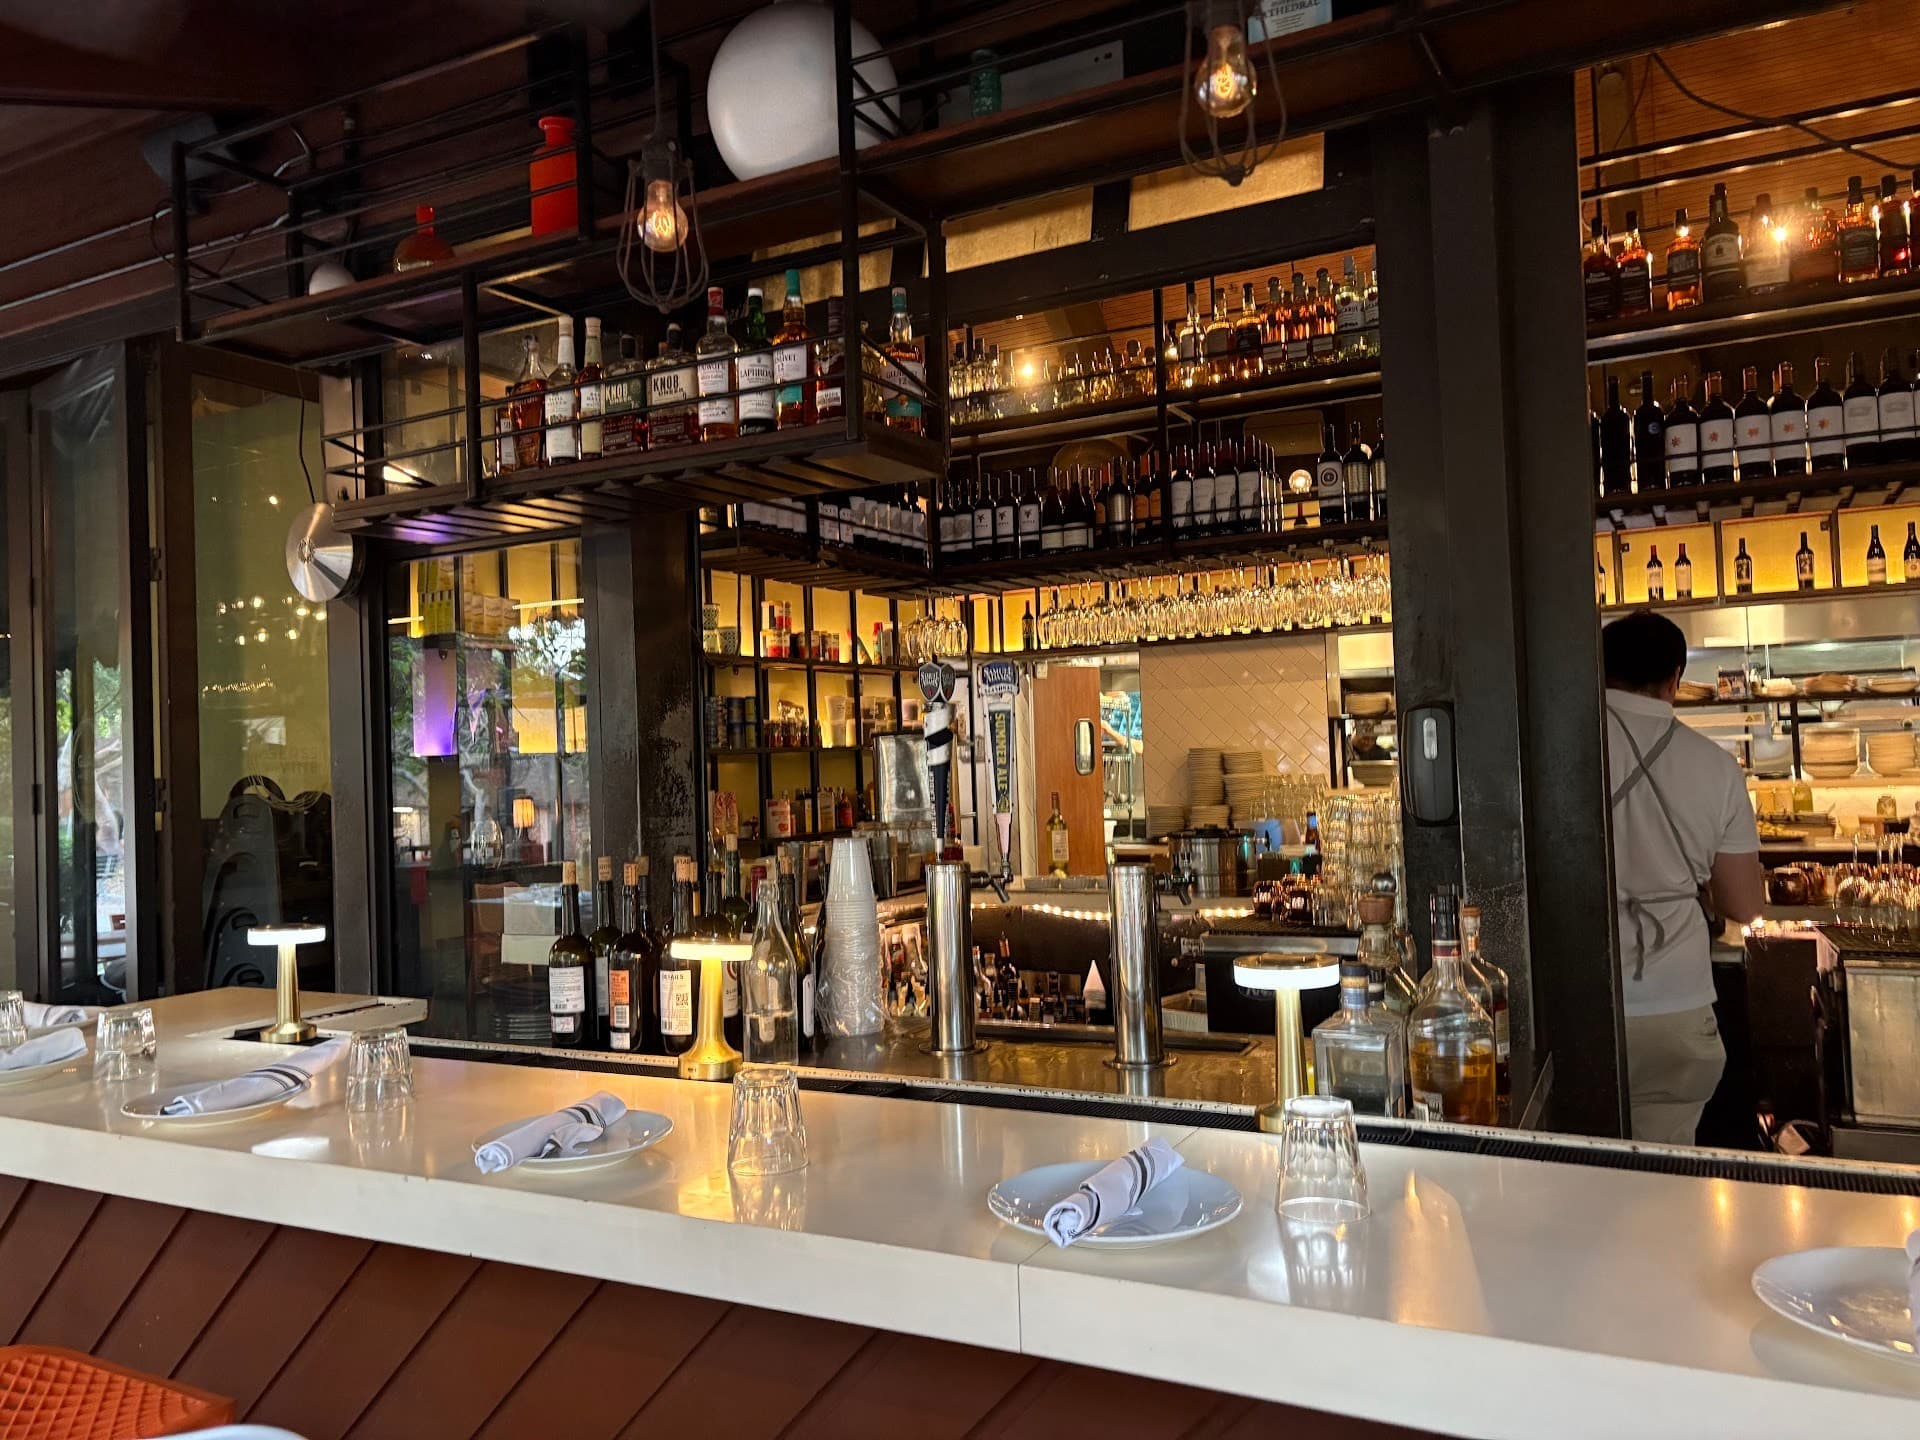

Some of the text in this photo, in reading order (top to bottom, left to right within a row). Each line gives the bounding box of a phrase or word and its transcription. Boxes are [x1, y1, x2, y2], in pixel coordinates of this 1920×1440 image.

[605, 382, 628, 401] KNOB
[653, 374, 679, 392] KNOB
[994, 712, 1009, 791] SUMMER ALE
